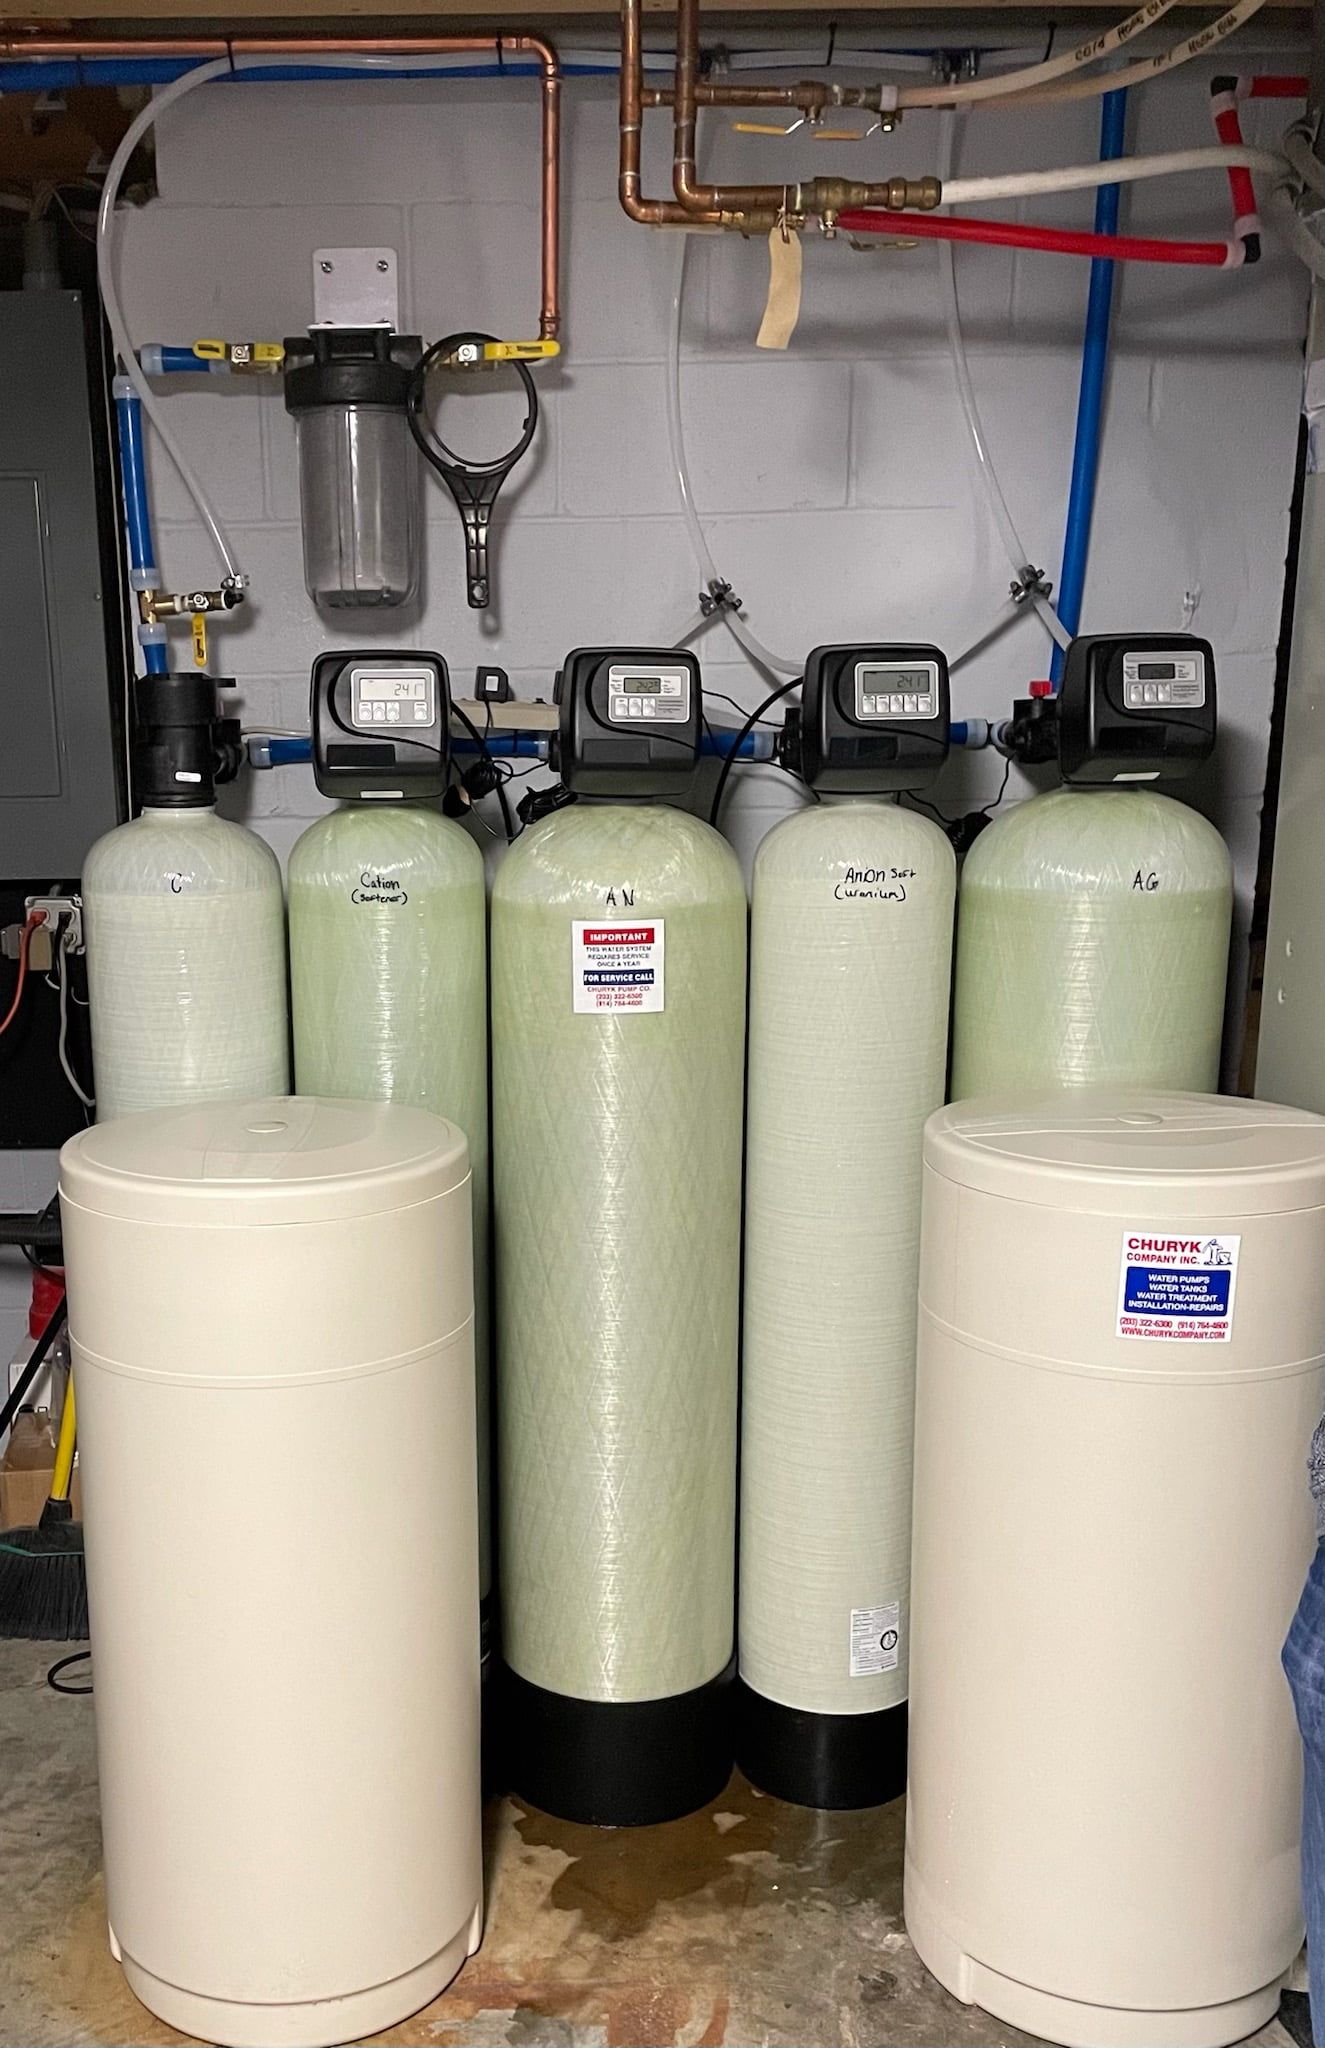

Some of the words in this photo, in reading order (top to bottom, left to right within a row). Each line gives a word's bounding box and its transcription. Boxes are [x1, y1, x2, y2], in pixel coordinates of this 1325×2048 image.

[171, 872, 182, 893] C
[360, 871, 400, 890] Cation
[589, 932, 648, 942] IMPORTANT
[584, 974, 600, 982] FOR
[600, 973, 633, 982] SERVICE
[634, 972, 654, 981] CALL
[617, 985, 638, 993] PUMP
[1128, 1238, 1202, 1253] CHURYK
[1126, 1252, 1177, 1264] COMPANY
[1179, 1256, 1200, 1265] INC.
[1148, 1273, 1178, 1283] WATER
[1179, 1275, 1210, 1284] PUMPS
[1148, 1283, 1179, 1292] WATER
[1180, 1284, 1208, 1293] TANKS
[1136, 1291, 1167, 1300] WATER
[1168, 1293, 1218, 1302] TREATMENT
[1127, 1300, 1225, 1311] INSTALLATION-REPAIRS
